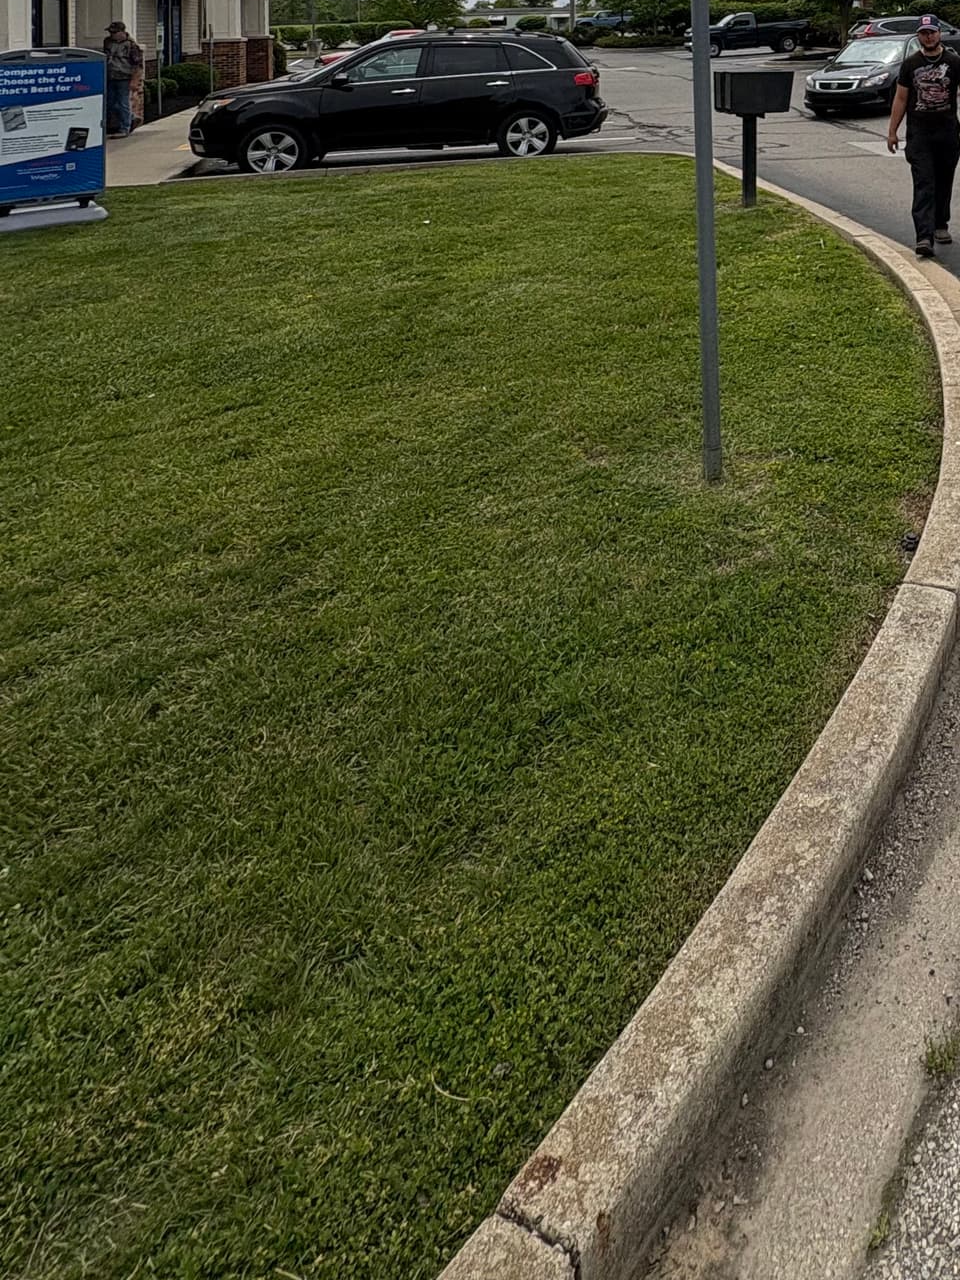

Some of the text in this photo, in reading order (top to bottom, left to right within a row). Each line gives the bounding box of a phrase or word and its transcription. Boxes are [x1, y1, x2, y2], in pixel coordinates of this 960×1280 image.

[0, 78, 35, 86] Choose
[58, 75, 81, 83] Card
[30, 86, 53, 94] Best
[56, 84, 72, 92] for
